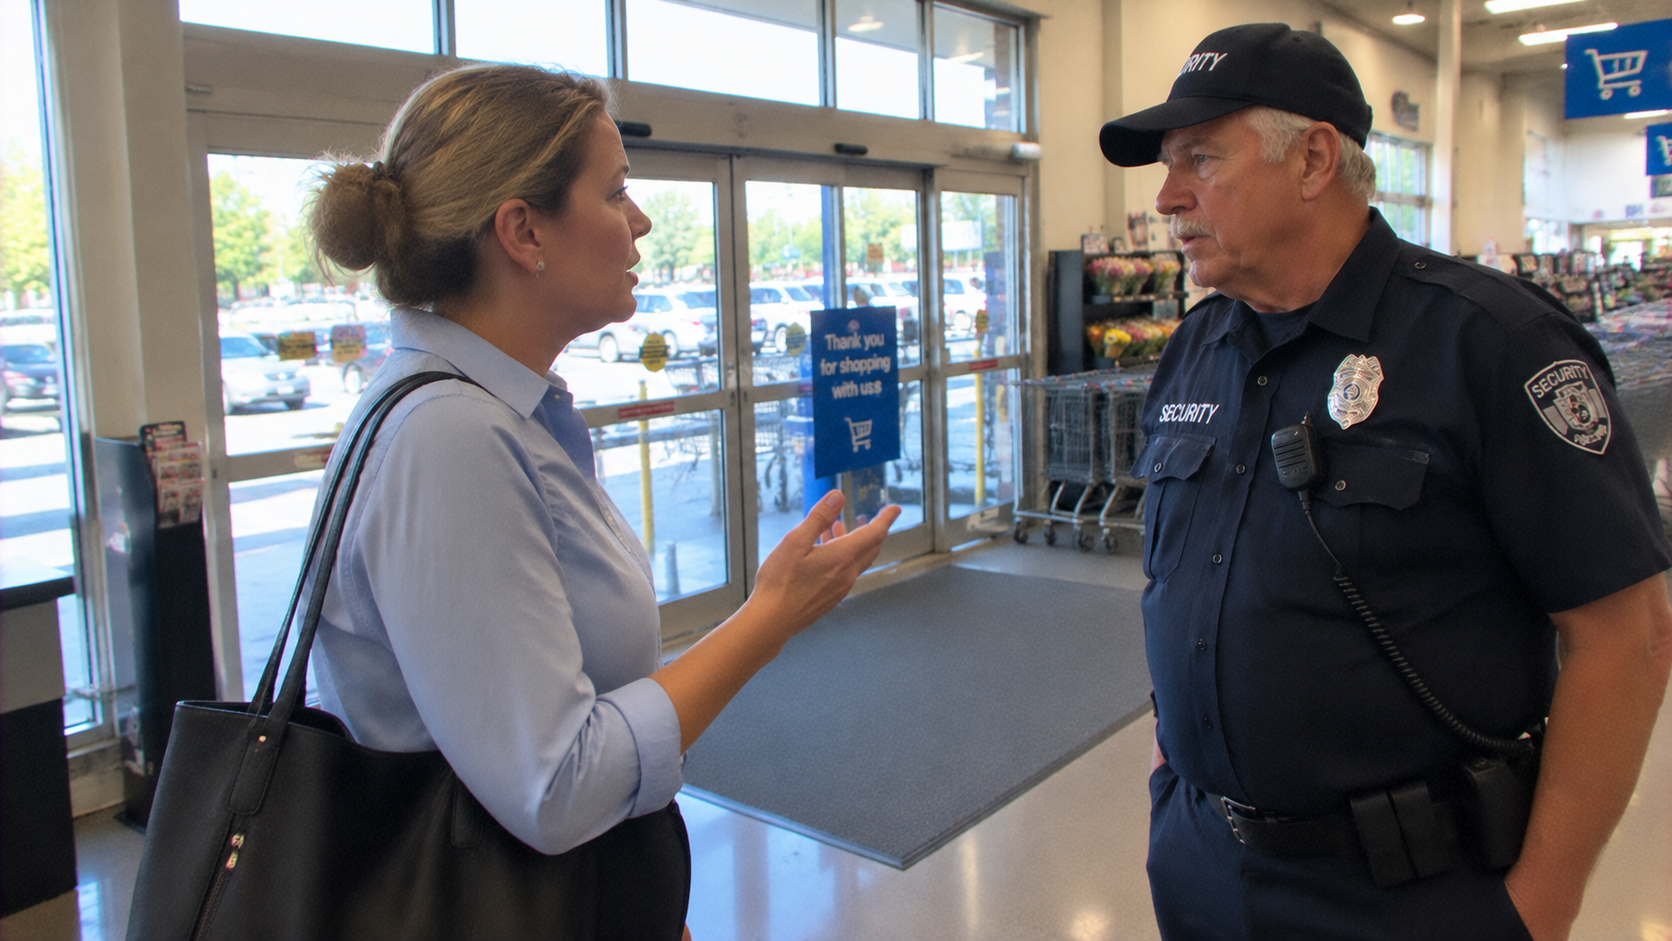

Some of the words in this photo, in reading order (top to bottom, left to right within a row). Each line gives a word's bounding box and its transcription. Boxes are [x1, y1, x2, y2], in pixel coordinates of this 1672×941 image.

[825, 332, 861, 350] Thank
[863, 333, 885, 351] you
[820, 358, 837, 376] for
[839, 354, 891, 376] shopping
[831, 380, 858, 399] with
[1532, 365, 1588, 398] SECURITY
[1159, 403, 1219, 424] SECURITY
